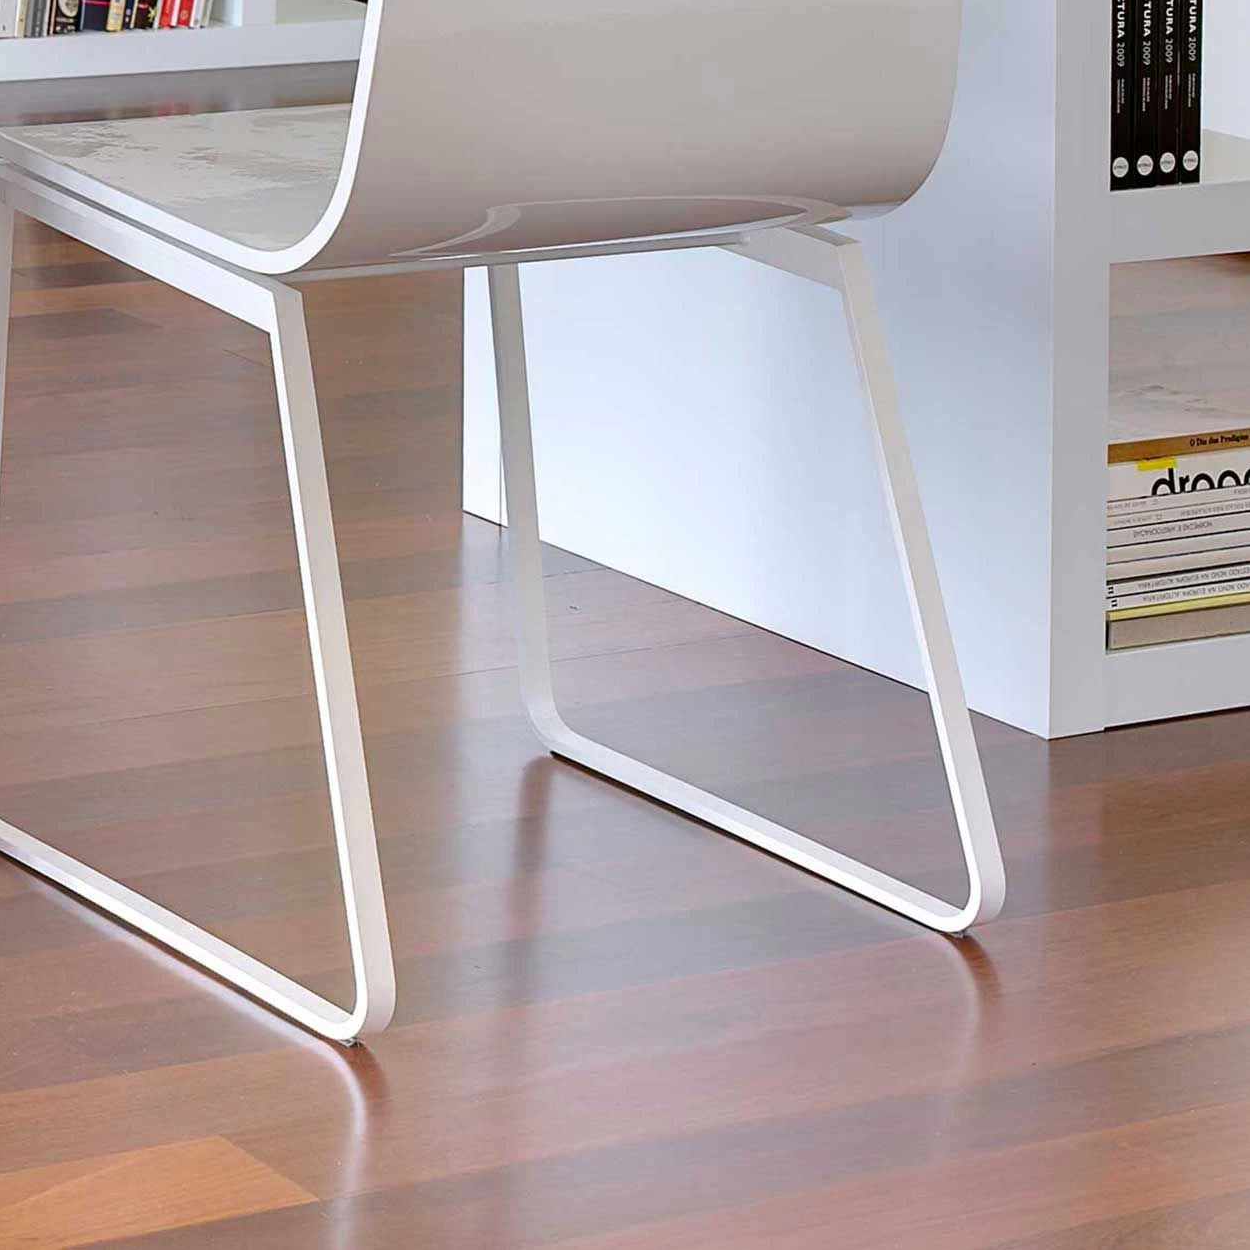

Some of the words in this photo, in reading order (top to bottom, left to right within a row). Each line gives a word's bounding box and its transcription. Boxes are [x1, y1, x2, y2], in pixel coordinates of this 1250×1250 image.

[1117, 42, 1125, 67] 2009
[1143, 41, 1151, 65] 2009
[1165, 39, 1173, 63] 2009
